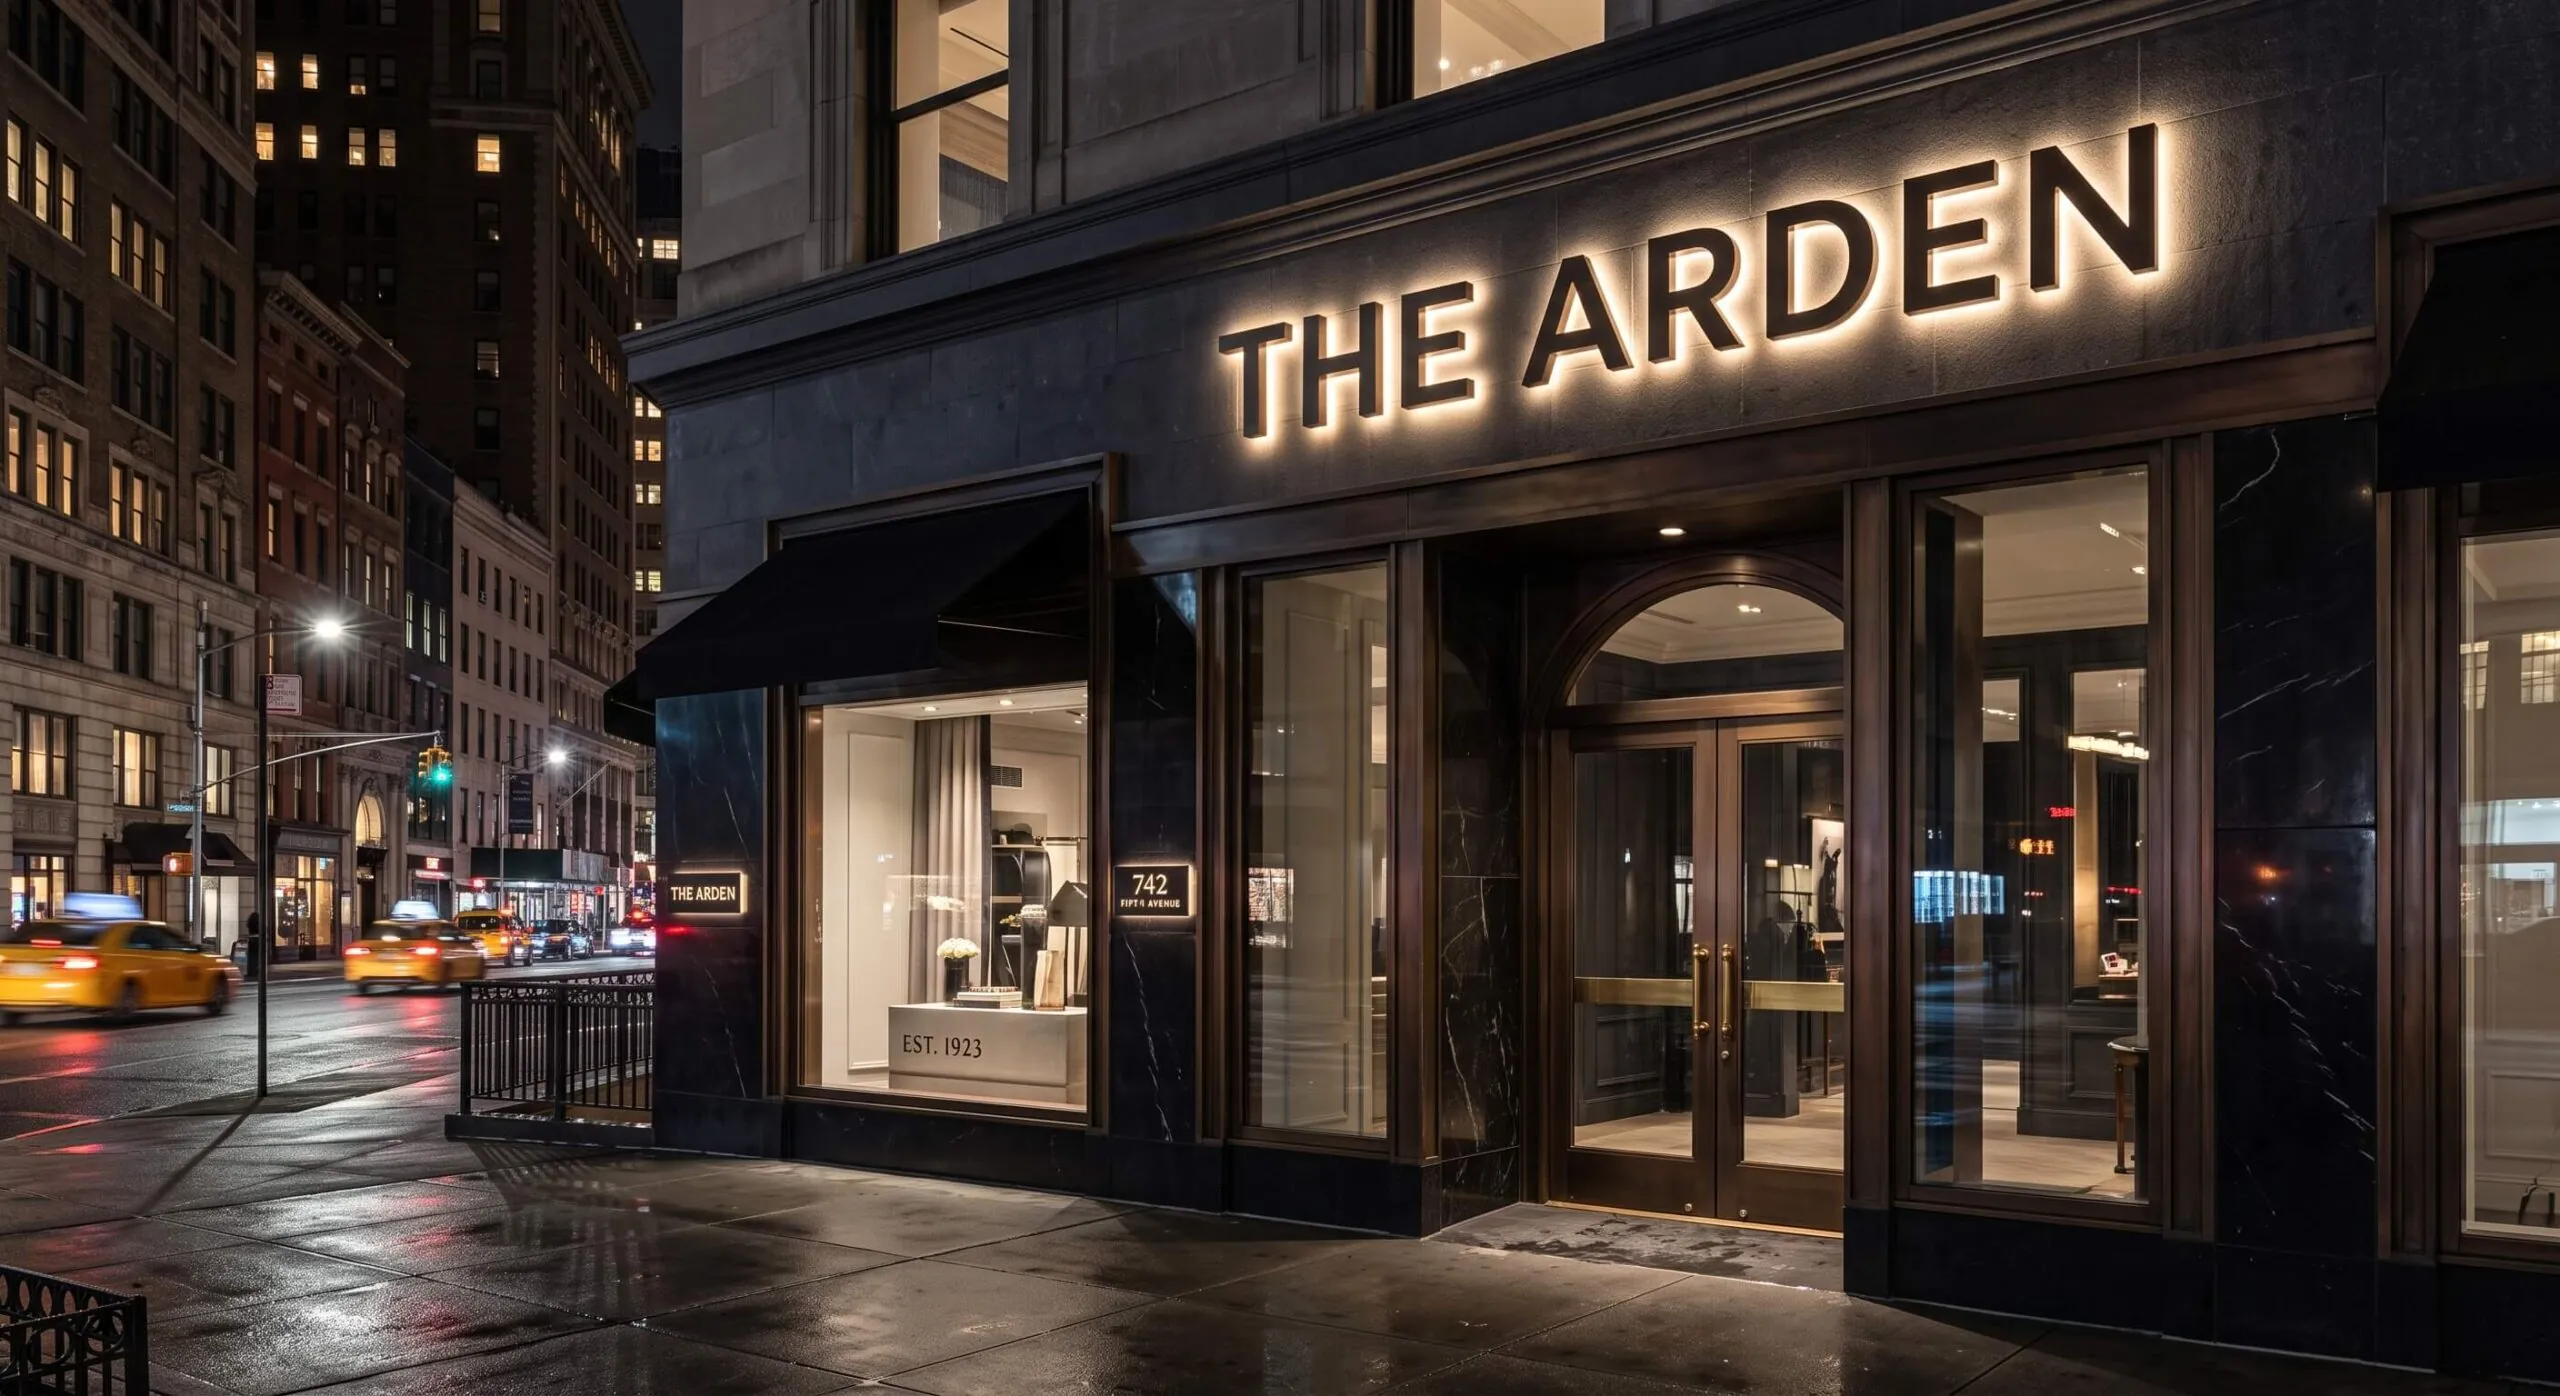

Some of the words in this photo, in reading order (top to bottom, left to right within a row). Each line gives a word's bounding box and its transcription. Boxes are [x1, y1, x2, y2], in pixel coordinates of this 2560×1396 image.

[1219, 281, 1475, 439] THE
[1521, 123, 2159, 388] ARDEN
[670, 886, 694, 901] THE
[695, 886, 736, 901] ARDEN
[1132, 873, 1168, 895] 742
[1147, 898, 1181, 908] AVENUE
[903, 1034, 938, 1054] EST.
[945, 1037, 982, 1058] 1923
